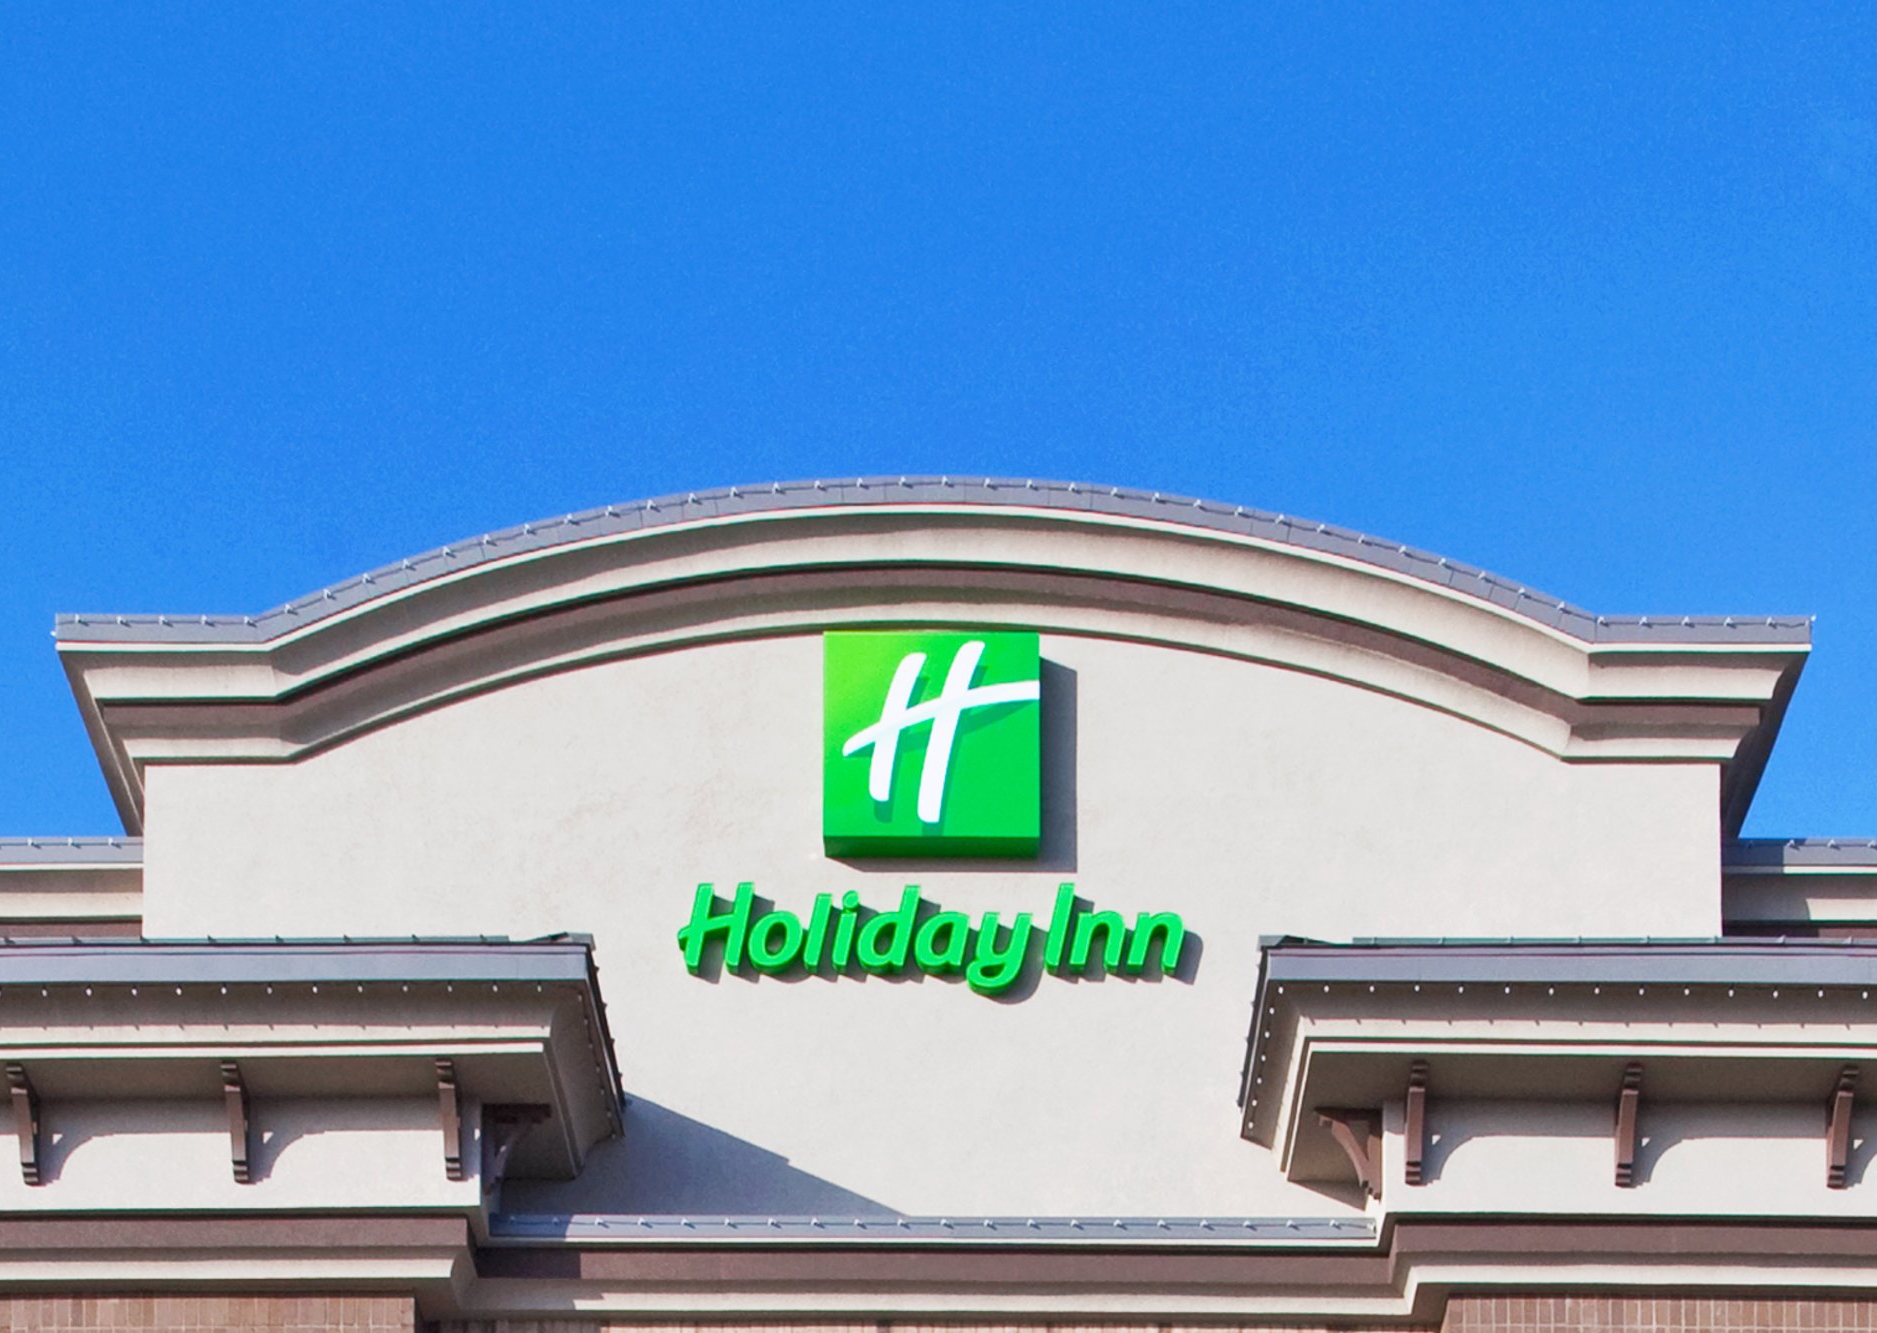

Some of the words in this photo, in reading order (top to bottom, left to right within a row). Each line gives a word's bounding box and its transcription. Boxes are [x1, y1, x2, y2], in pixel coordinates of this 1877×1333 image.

[843, 641, 1040, 823] H
[677, 882, 1033, 996] Holiday
[1044, 882, 1187, 976] Inn
